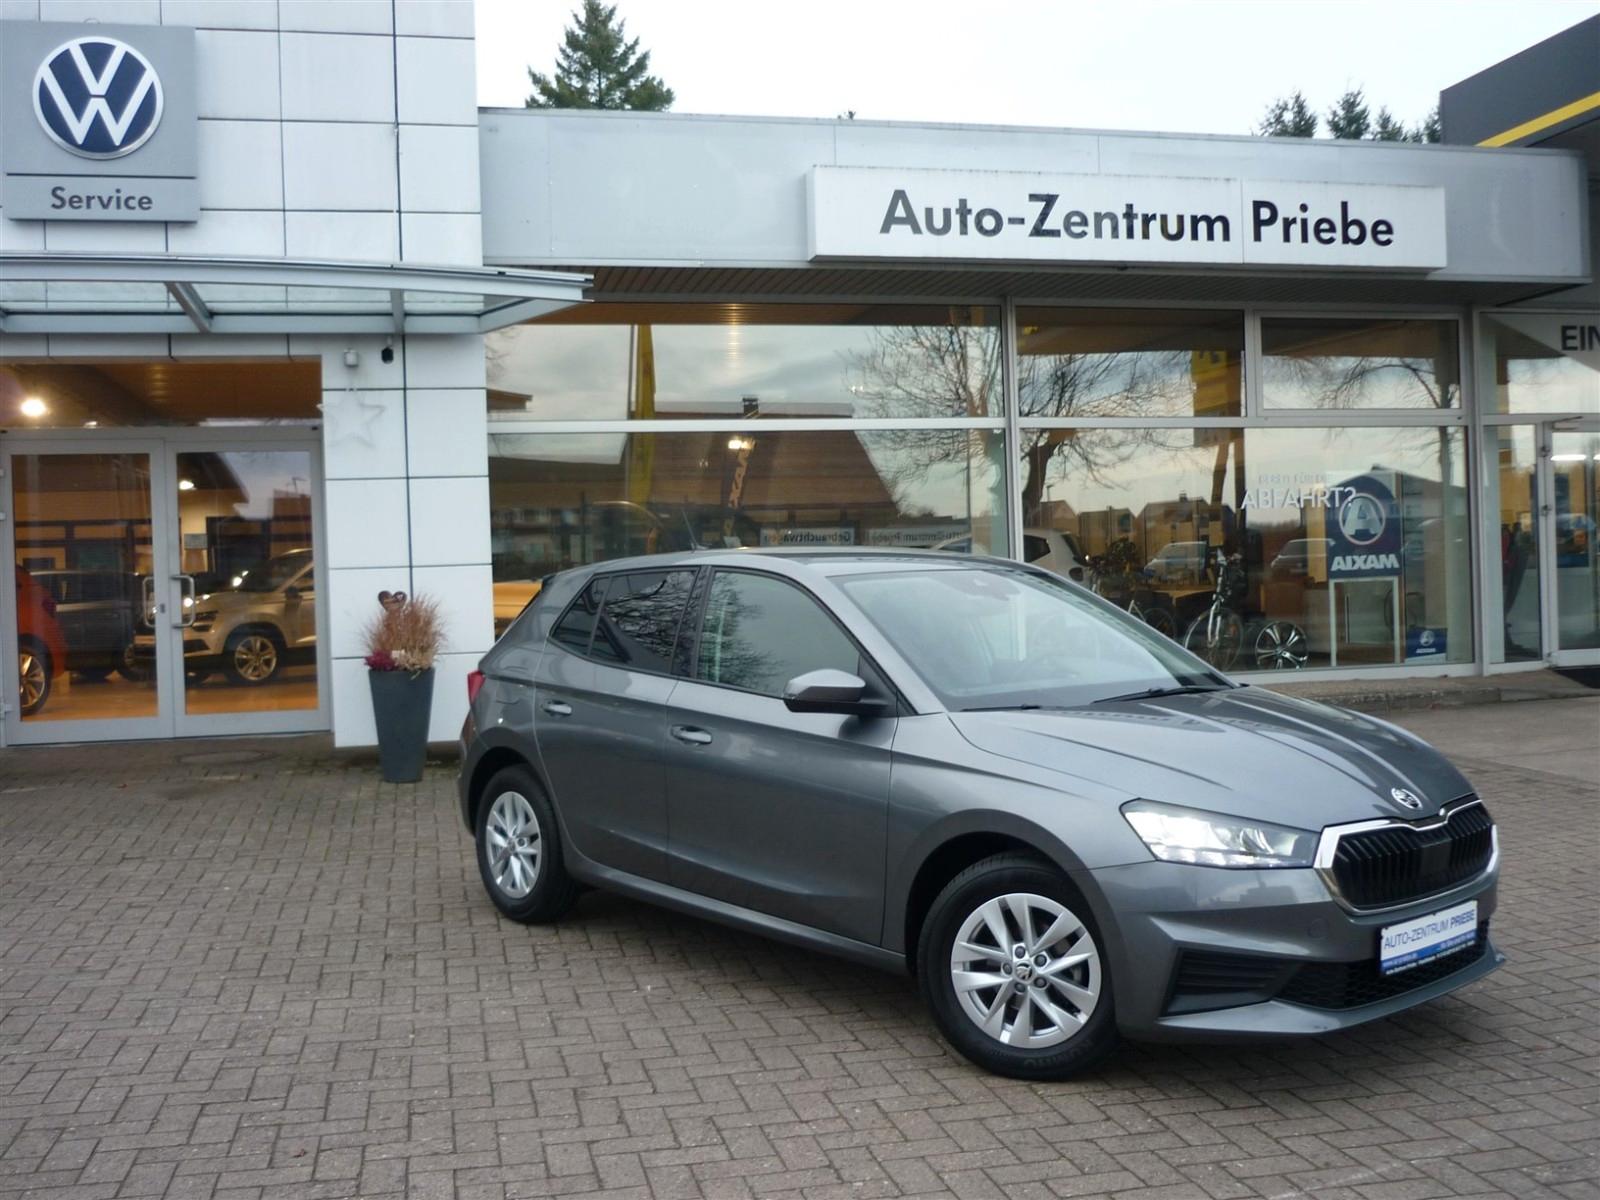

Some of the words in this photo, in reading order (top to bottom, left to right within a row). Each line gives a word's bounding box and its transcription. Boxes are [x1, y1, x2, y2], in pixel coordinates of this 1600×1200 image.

[35, 39, 160, 152] VW
[51, 186, 153, 210] Service
[880, 189, 1231, 243] Auto-Zentrum
[1252, 200, 1395, 247] Priebe
[1331, 553, 1400, 571] AIXAM
[1384, 918, 1448, 949] AUTO-ZENTRUM
[1450, 909, 1475, 928] PRIEBE
